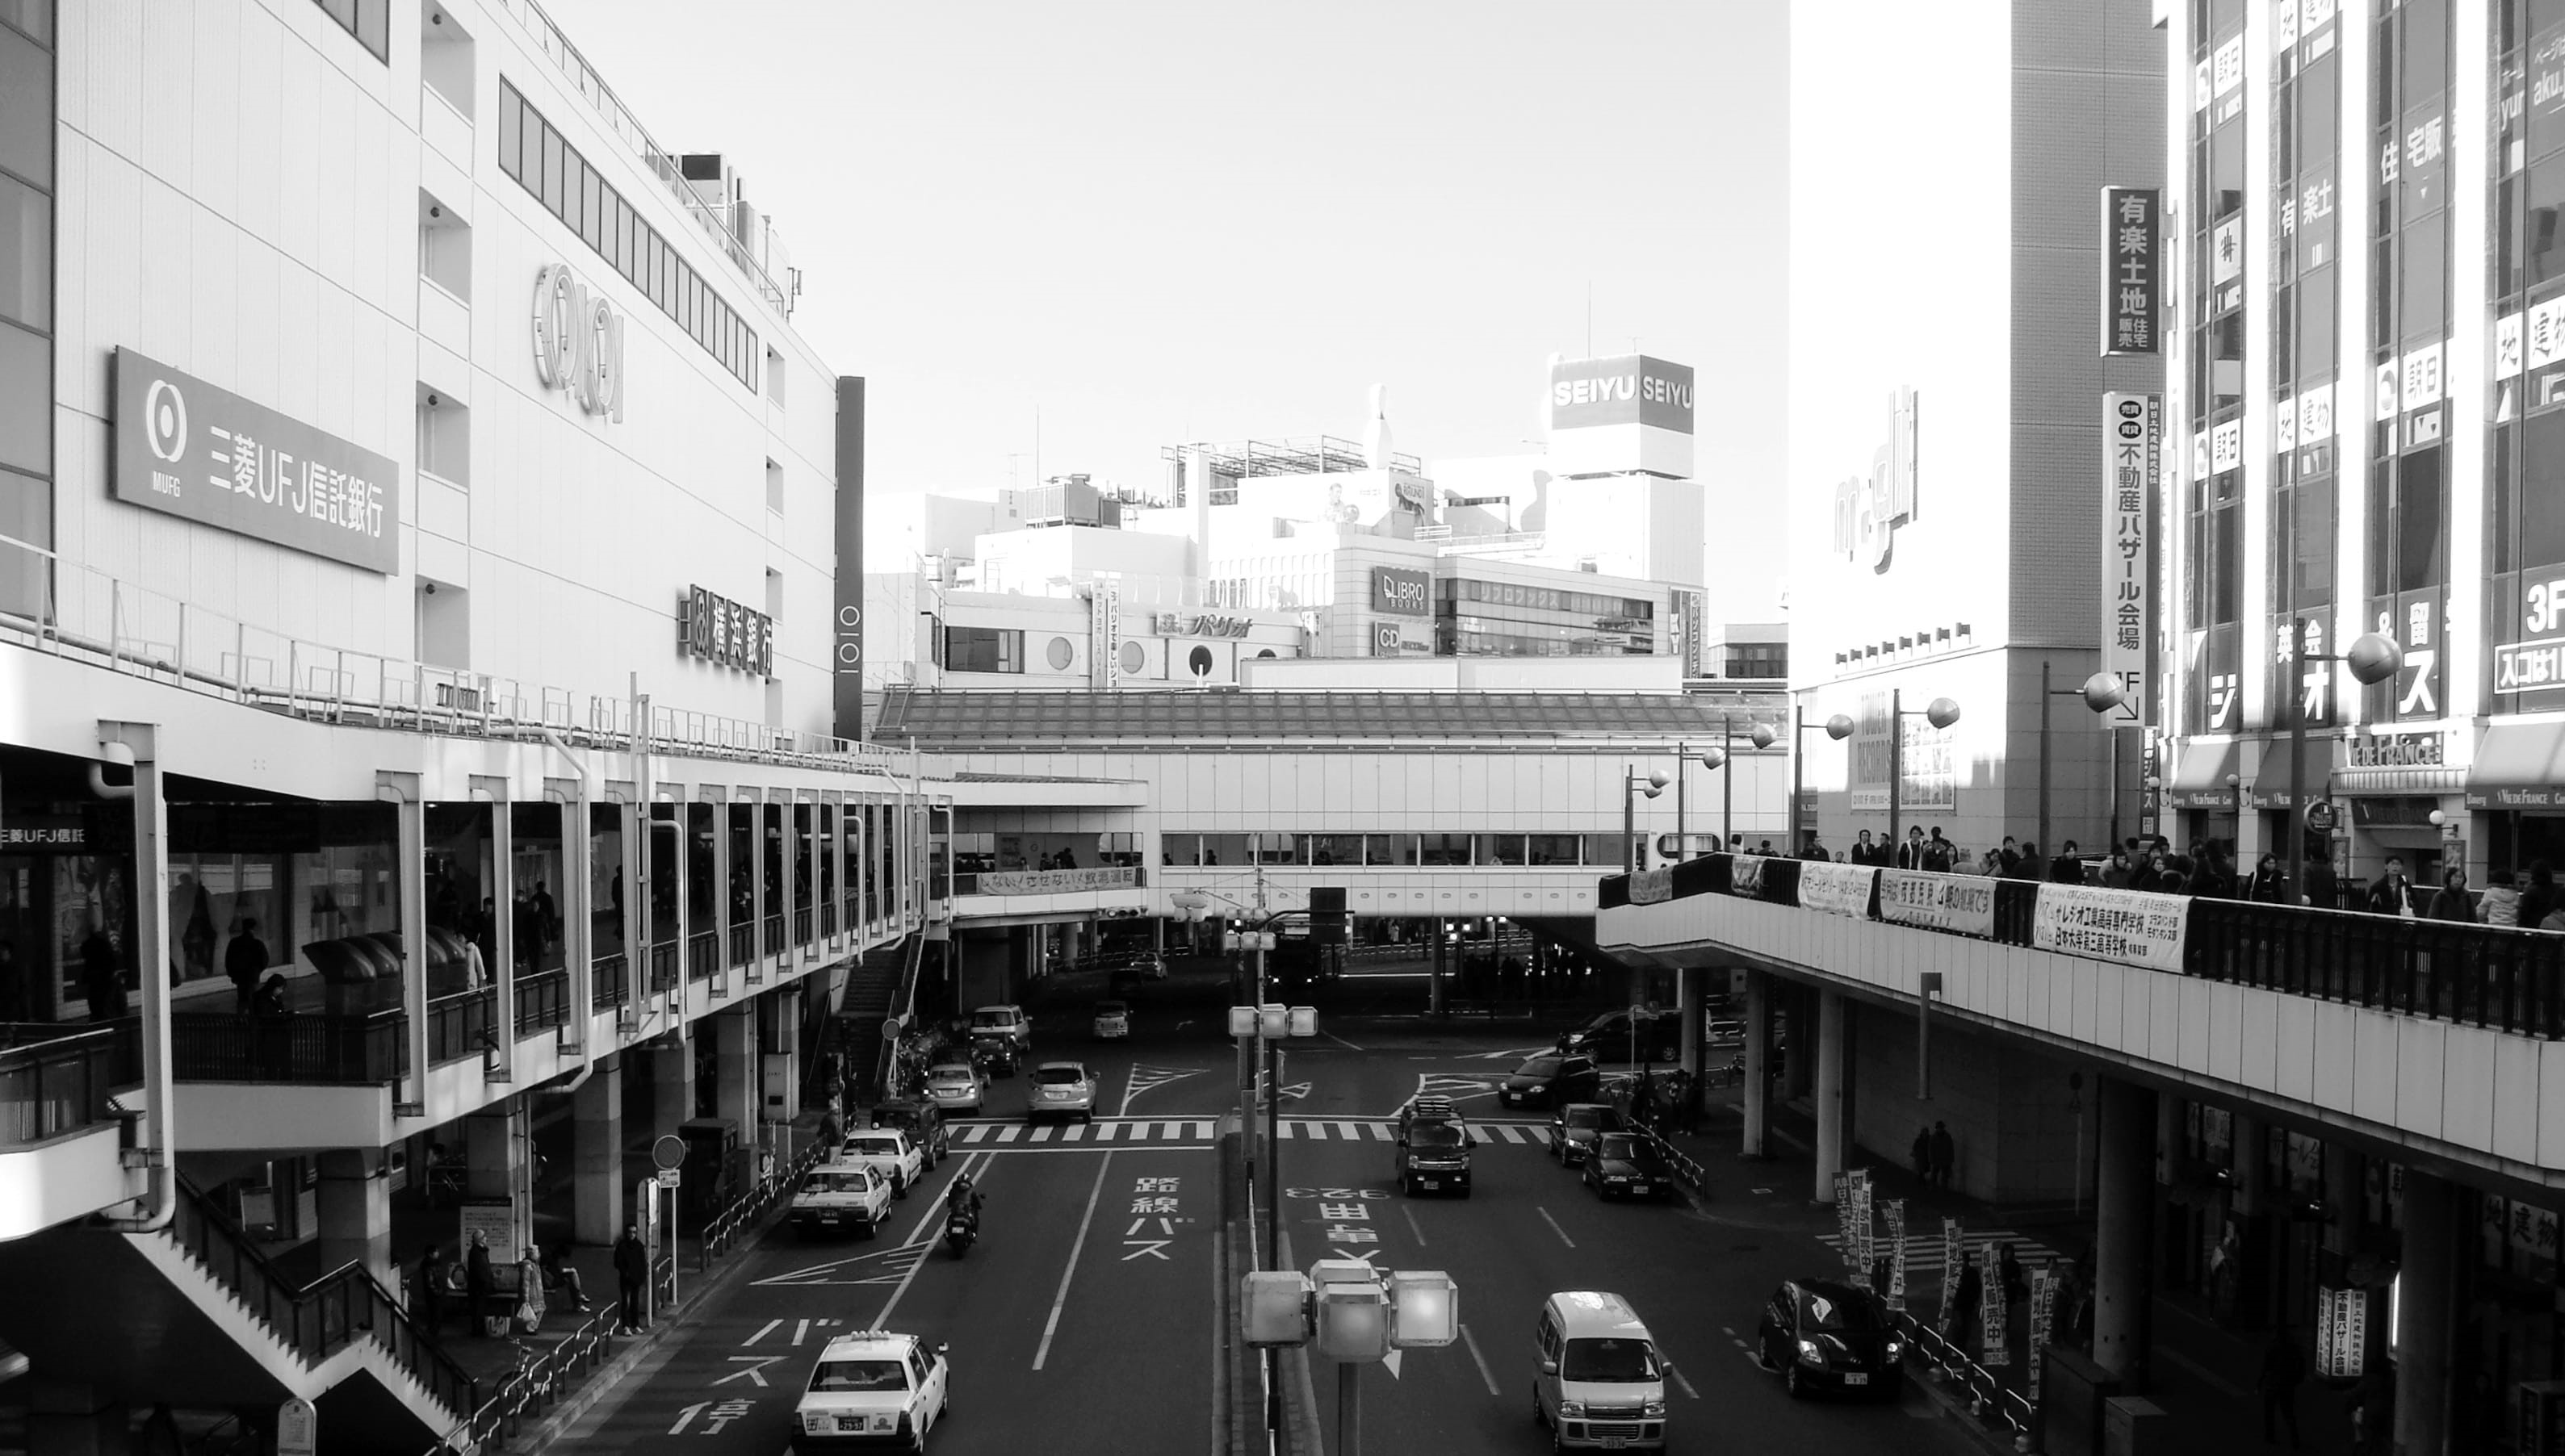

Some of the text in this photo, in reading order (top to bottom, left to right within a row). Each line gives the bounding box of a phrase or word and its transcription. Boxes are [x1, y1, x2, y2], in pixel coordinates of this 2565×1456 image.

[2119, 195, 2148, 316] 有楽土地
[1553, 375, 1637, 407] SEIYU
[1642, 375, 1693, 409] SEIYU
[153, 471, 181, 498] MUFG
[210, 425, 383, 538] 三菱UFJ信託銀行
[2118, 442, 2141, 651] 不動産バザール会場
[1384, 575, 1424, 601] LIBRO
[1391, 598, 1423, 610] BOOKS
[2526, 579, 2565, 634] 3F
[713, 600, 773, 671] 横浜銀行
[1380, 628, 1399, 648] CD
[0, 828, 85, 843] 三菱UFJ信託
